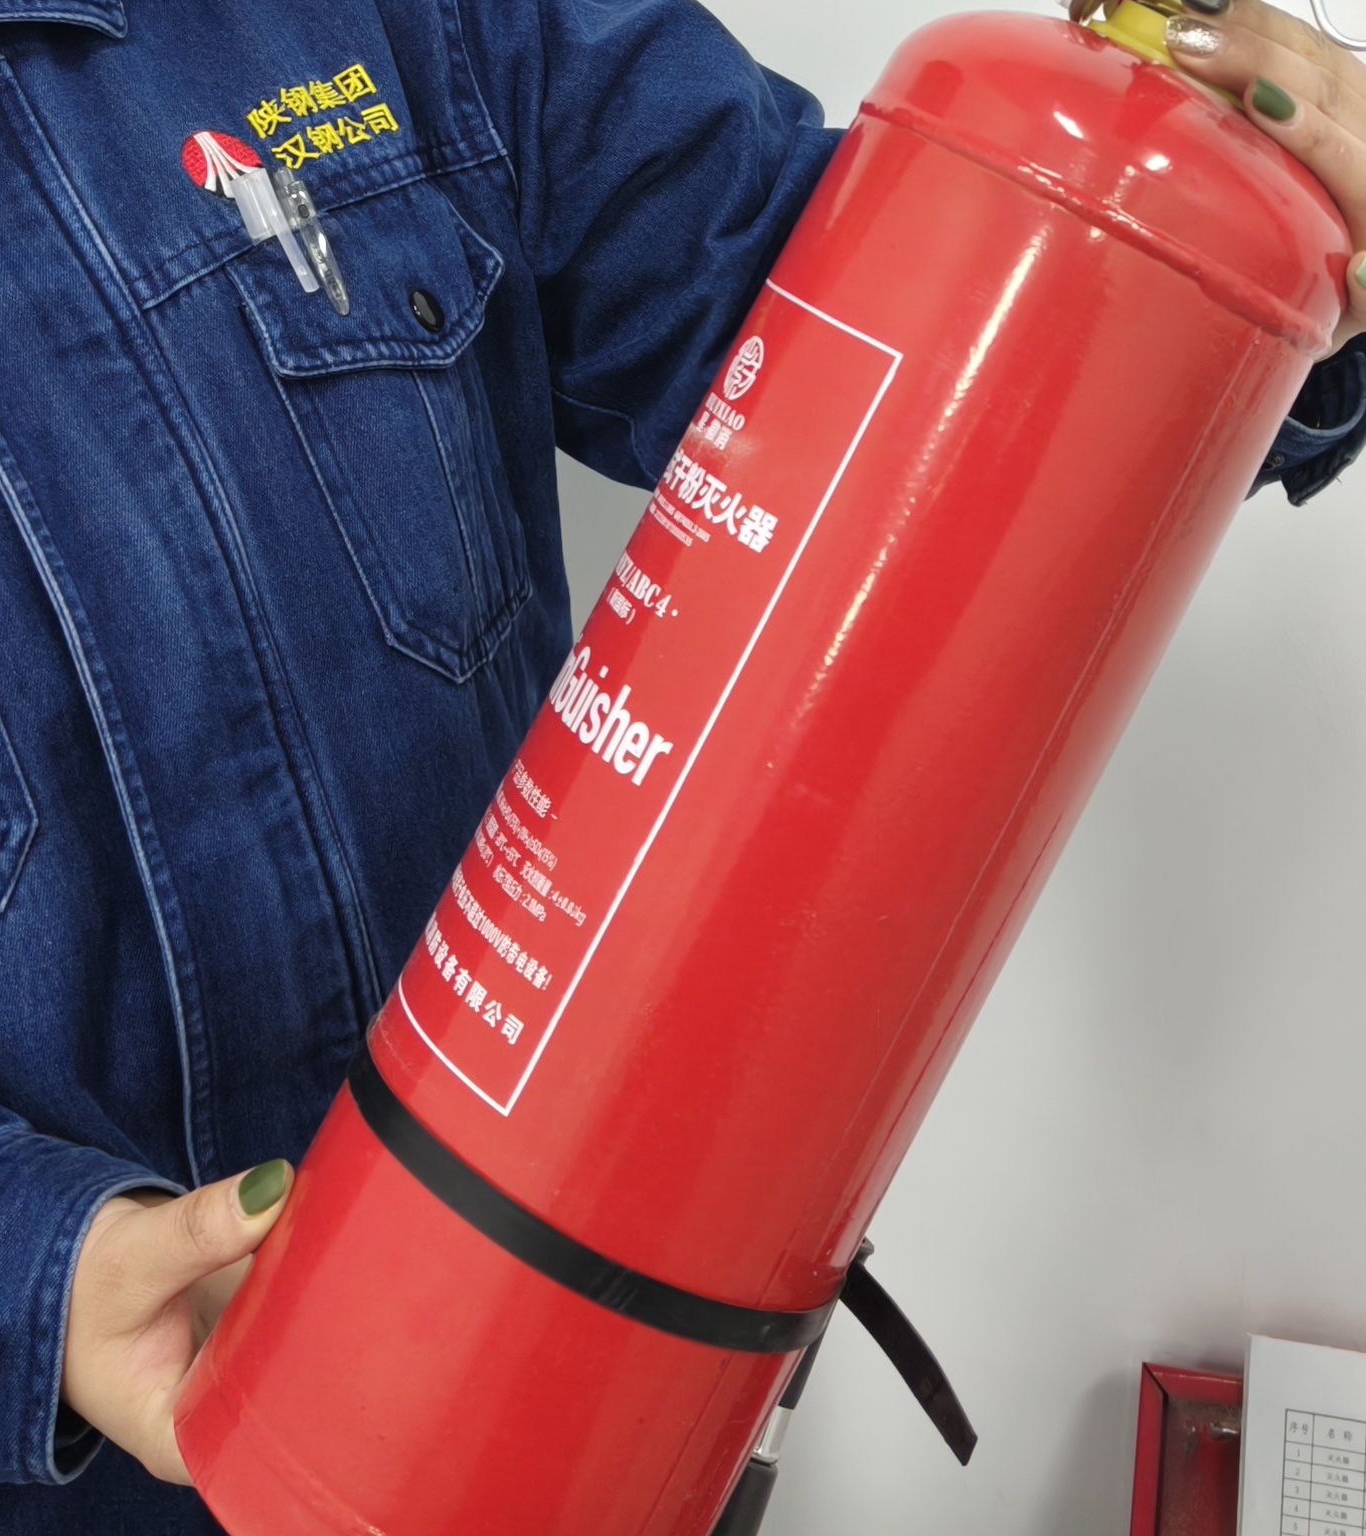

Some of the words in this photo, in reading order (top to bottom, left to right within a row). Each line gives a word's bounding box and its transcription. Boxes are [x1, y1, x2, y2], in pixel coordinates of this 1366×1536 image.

[246, 63, 377, 139] 陕钢集团
[271, 103, 399, 170] 汉钢公司
